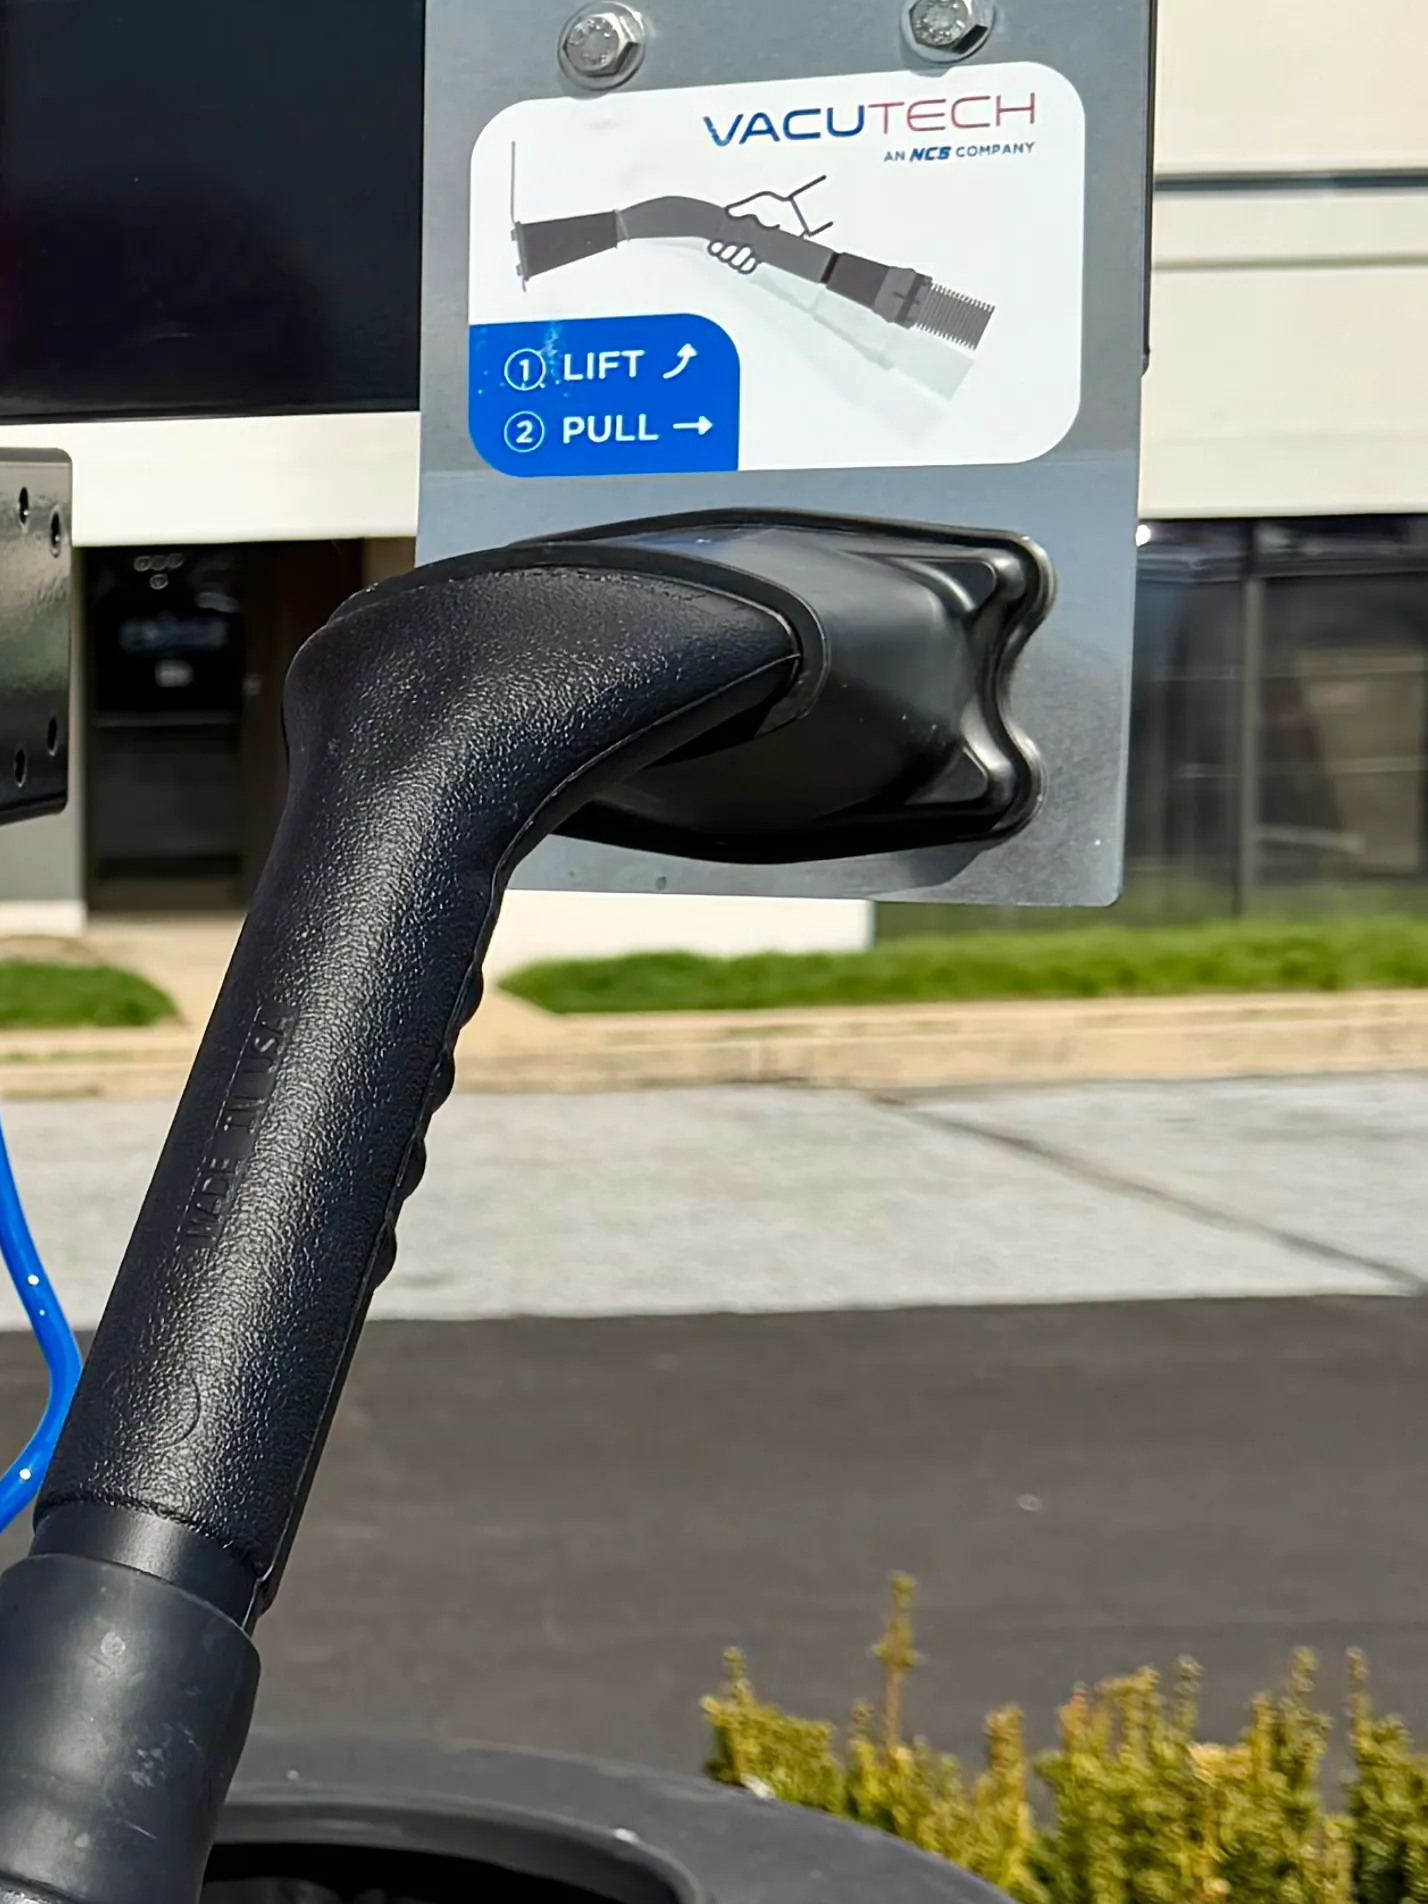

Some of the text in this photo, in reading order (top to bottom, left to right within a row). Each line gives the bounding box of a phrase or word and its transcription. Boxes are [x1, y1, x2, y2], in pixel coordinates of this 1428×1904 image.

[703, 92, 1035, 147] VACUTECH
[884, 151, 906, 163] AN
[955, 141, 1035, 158] COMPANY
[563, 349, 645, 381] LIFT
[562, 413, 659, 444] PULL
